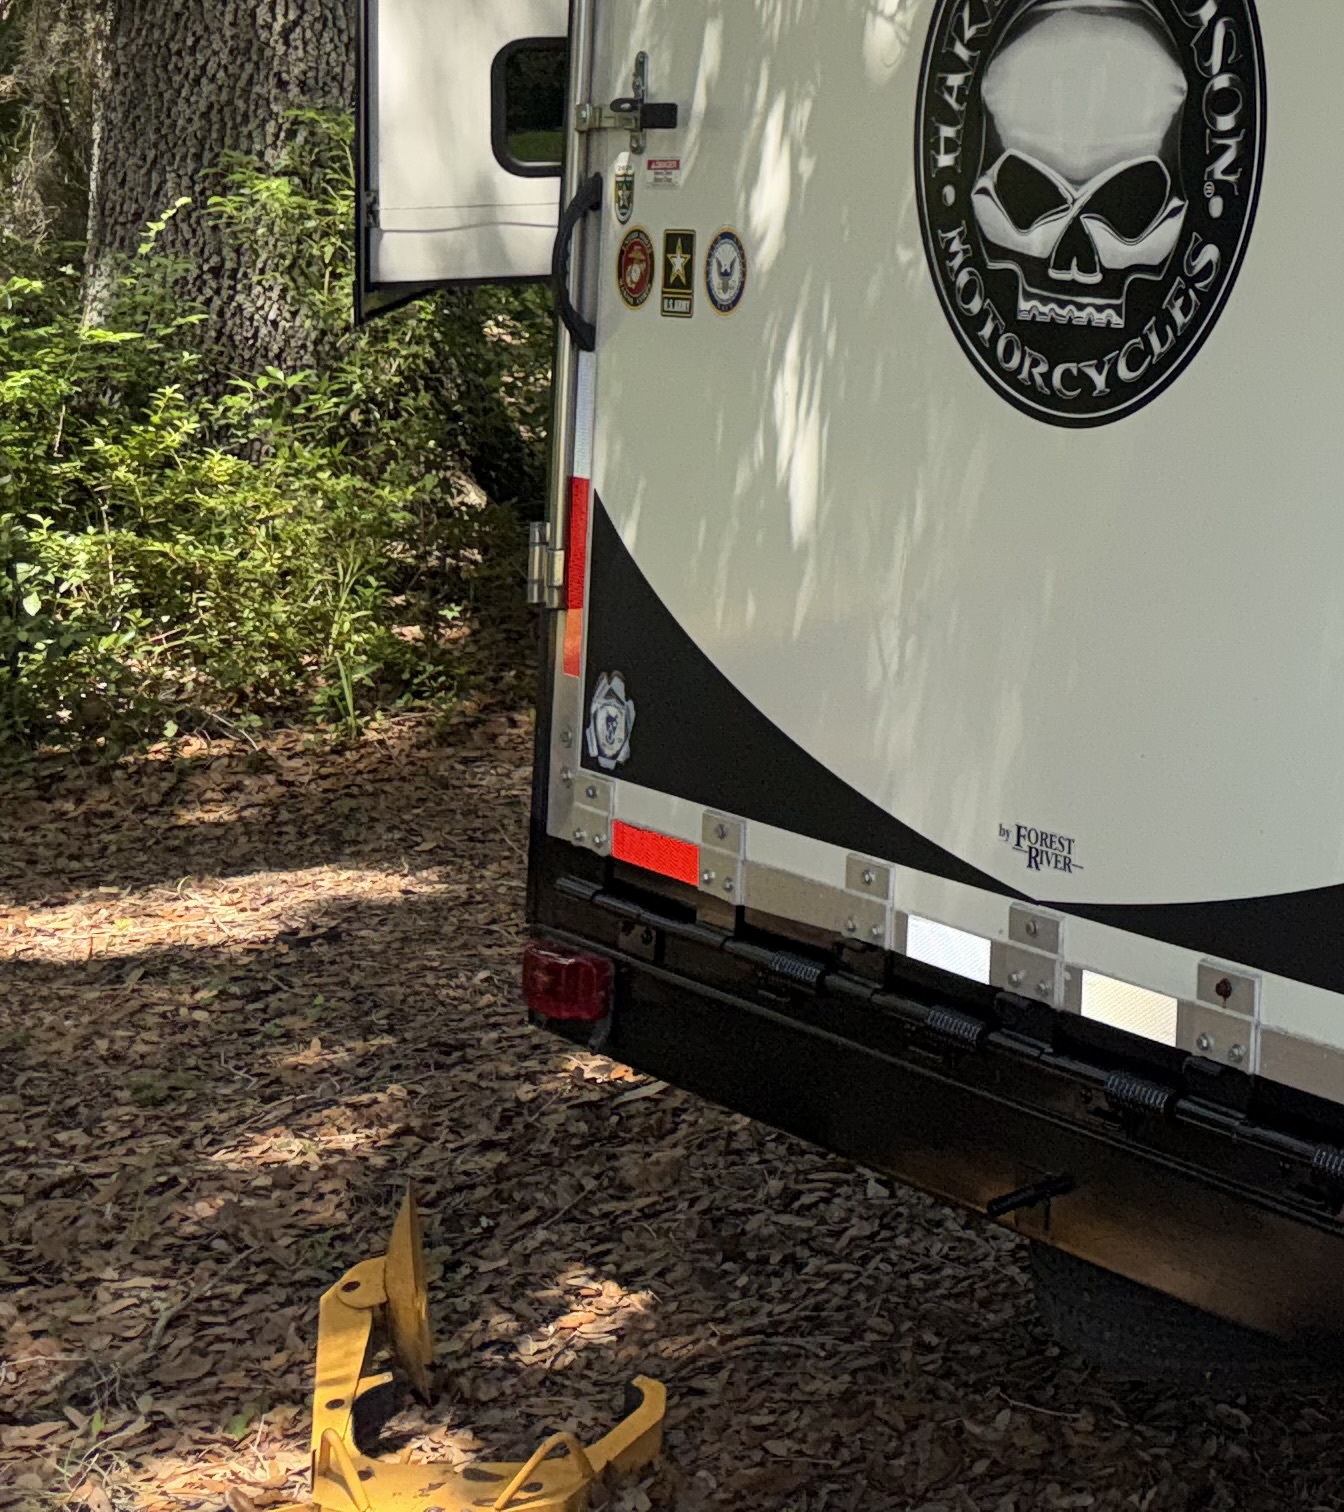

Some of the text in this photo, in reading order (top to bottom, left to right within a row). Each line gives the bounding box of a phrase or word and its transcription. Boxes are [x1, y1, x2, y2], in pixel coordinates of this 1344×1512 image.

[938, 220, 1223, 399] MOTORCYCLES
[999, 824, 1075, 855] by FOREST
[1027, 845, 1073, 873] RIVER
